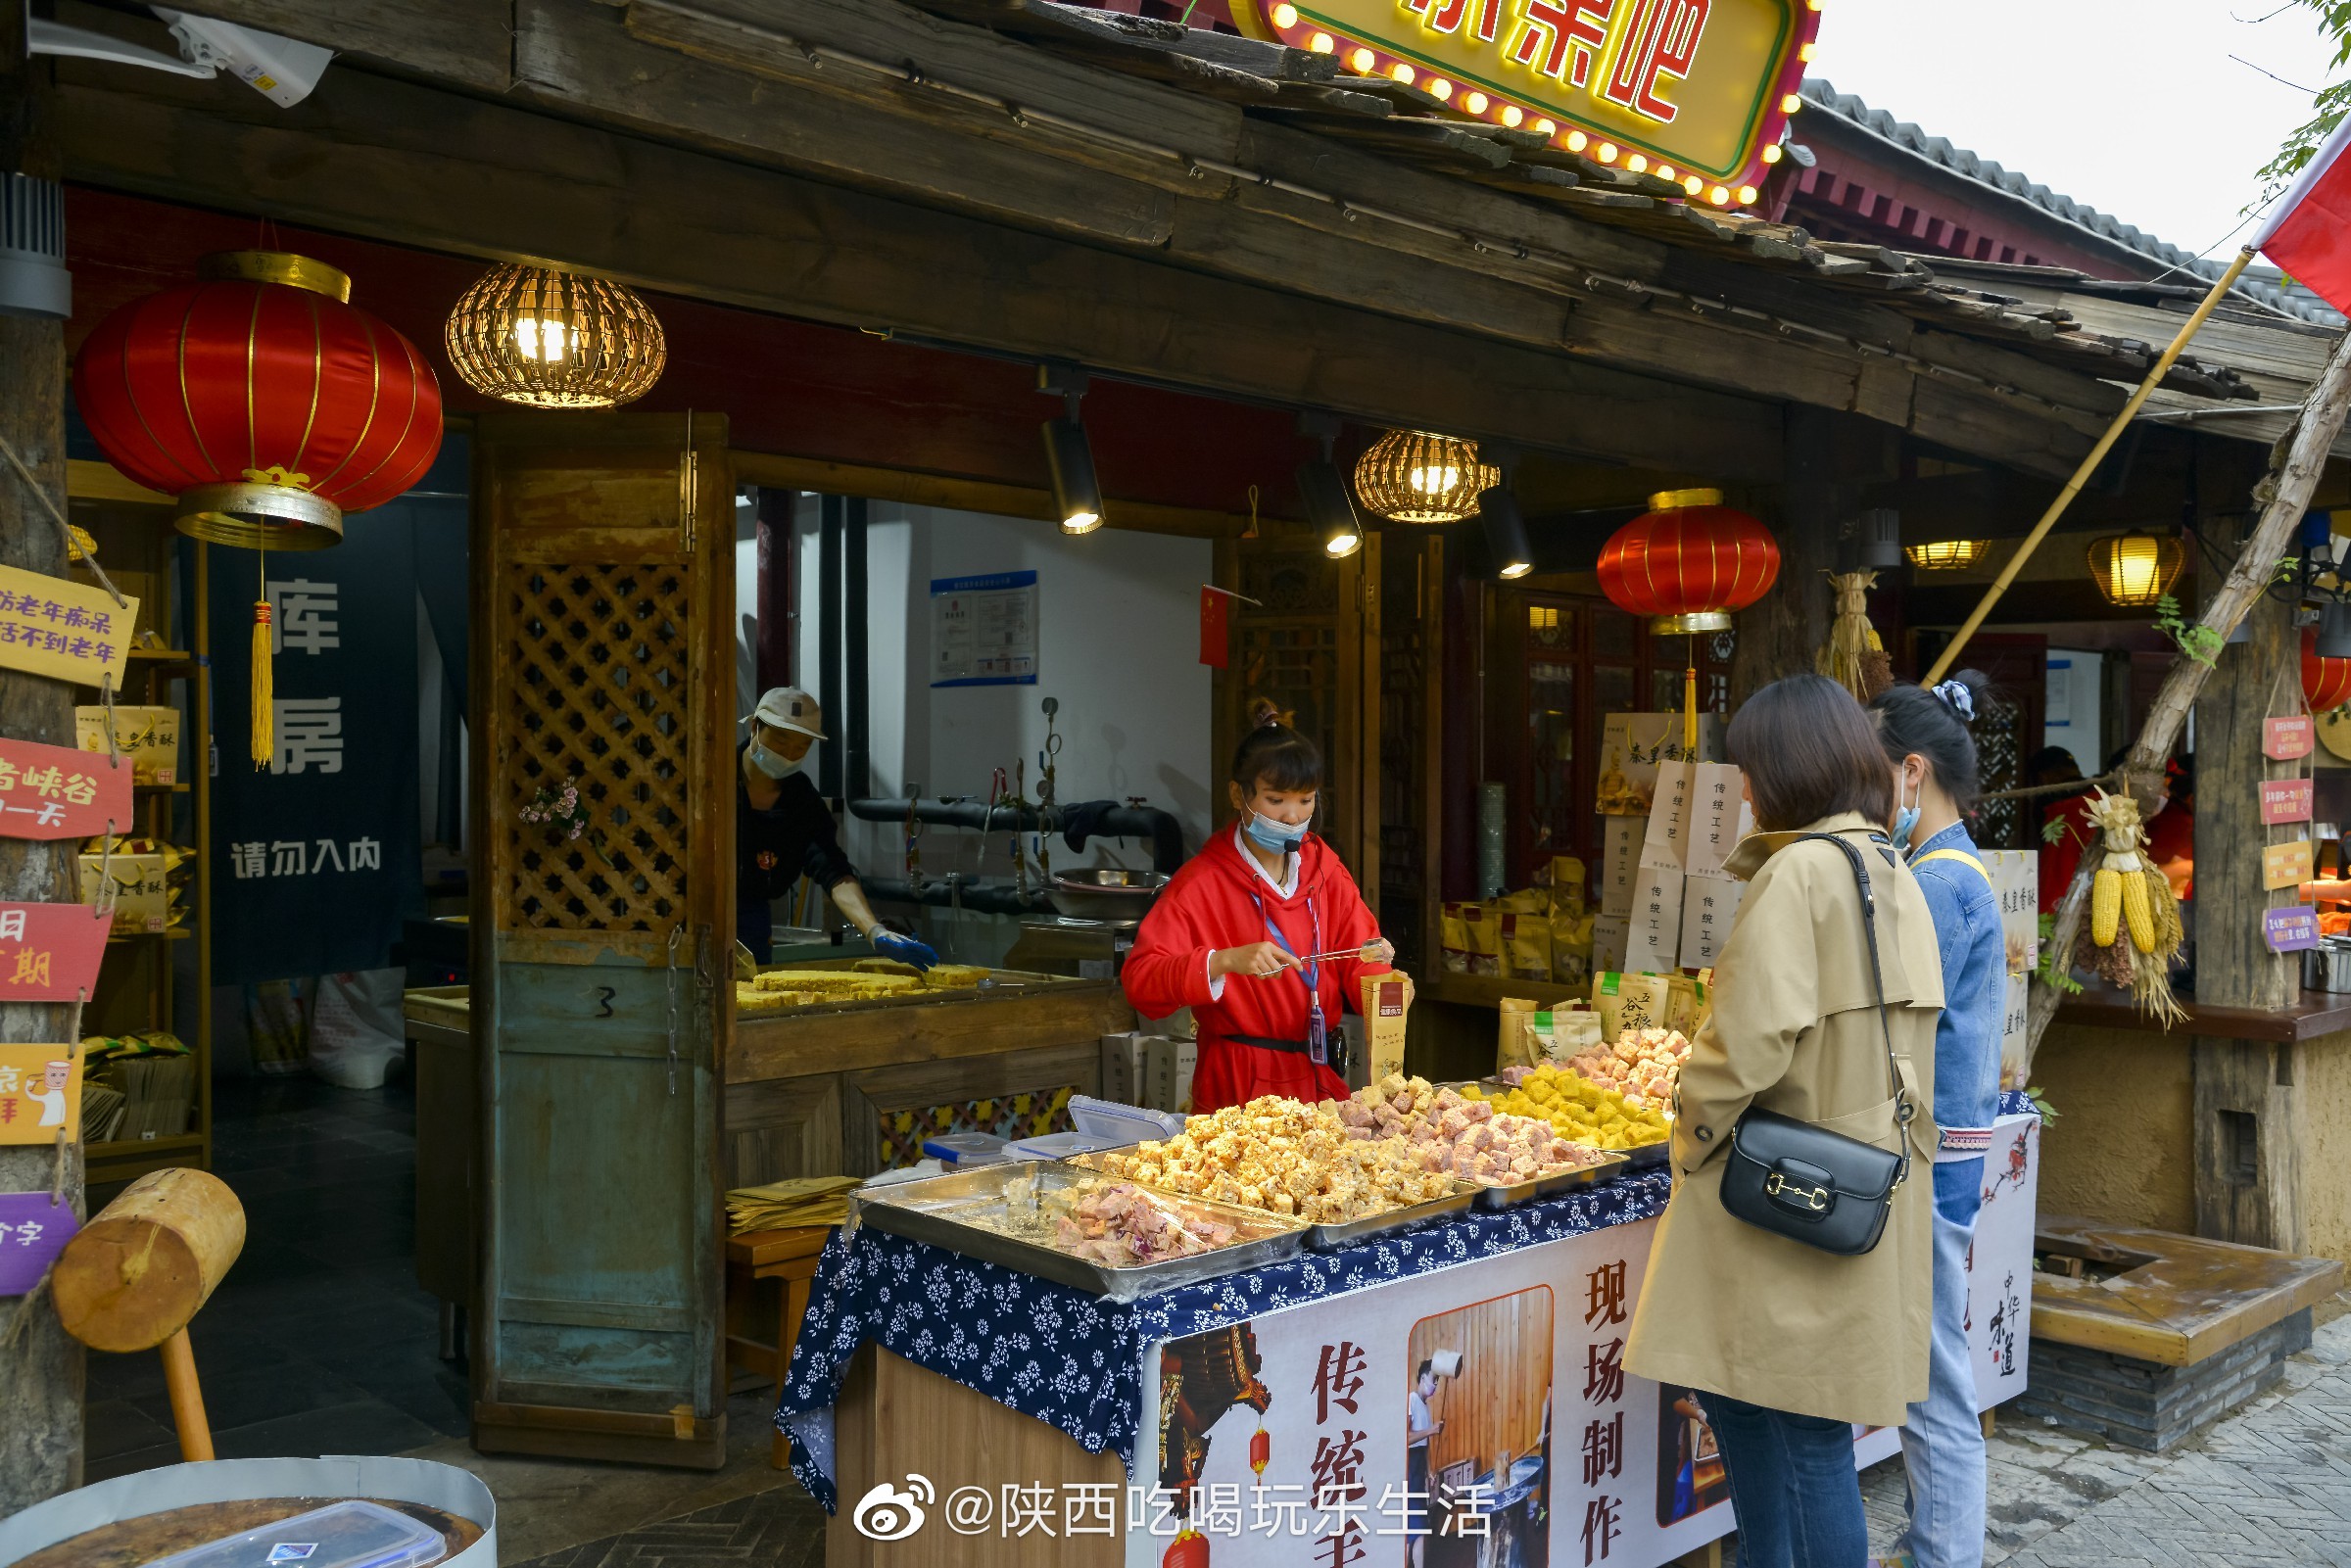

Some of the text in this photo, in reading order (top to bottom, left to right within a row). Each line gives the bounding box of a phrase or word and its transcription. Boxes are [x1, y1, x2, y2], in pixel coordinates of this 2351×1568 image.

[266, 578, 344, 775] 库房
[114, 730, 175, 748] 皇香酥
[0, 799, 67, 827] 一天
[1667, 780, 1686, 838] 传统工艺
[1709, 783, 1726, 843] 传统工艺
[230, 836, 380, 879] 请勿入内
[1617, 831, 1629, 885] 传统工艺
[1648, 886, 1662, 946] 传统工艺
[1701, 896, 1714, 957] 传统工艺
[0, 947, 51, 987] 期
[596, 986, 616, 1019] 3
[1580, 1259, 1627, 1568] 现场制作
